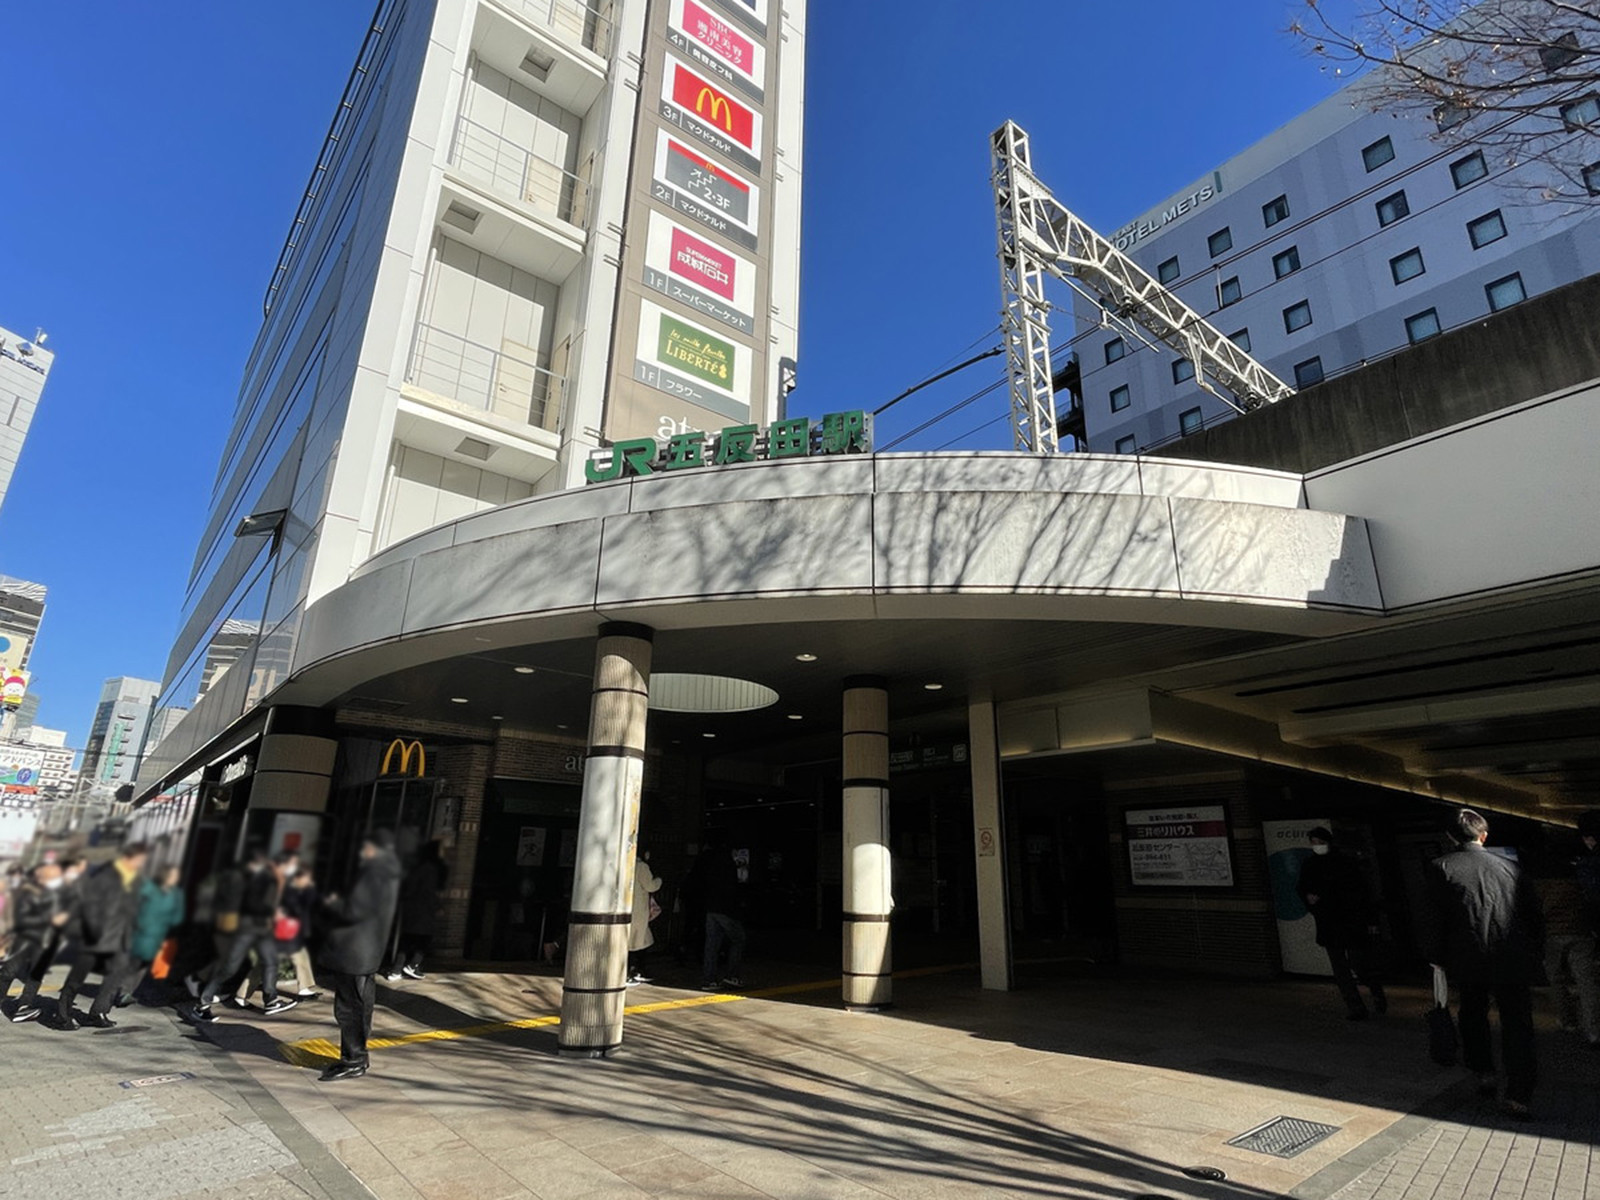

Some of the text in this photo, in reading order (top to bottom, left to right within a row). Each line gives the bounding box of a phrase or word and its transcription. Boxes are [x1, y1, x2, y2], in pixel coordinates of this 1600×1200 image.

[670, 34, 684, 46] 4F
[698, 31, 741, 64] クリニック
[663, 105, 732, 153] 3F マクドナルド
[655, 186, 727, 230] 2F マクドナルド
[1111, 184, 1214, 252] OTEL METS
[649, 271, 746, 328] 1F スーパーマーケット
[640, 364, 703, 399] 1F フラワー
[0, 755, 41, 766] アドバンス
[565, 754, 584, 772] at
